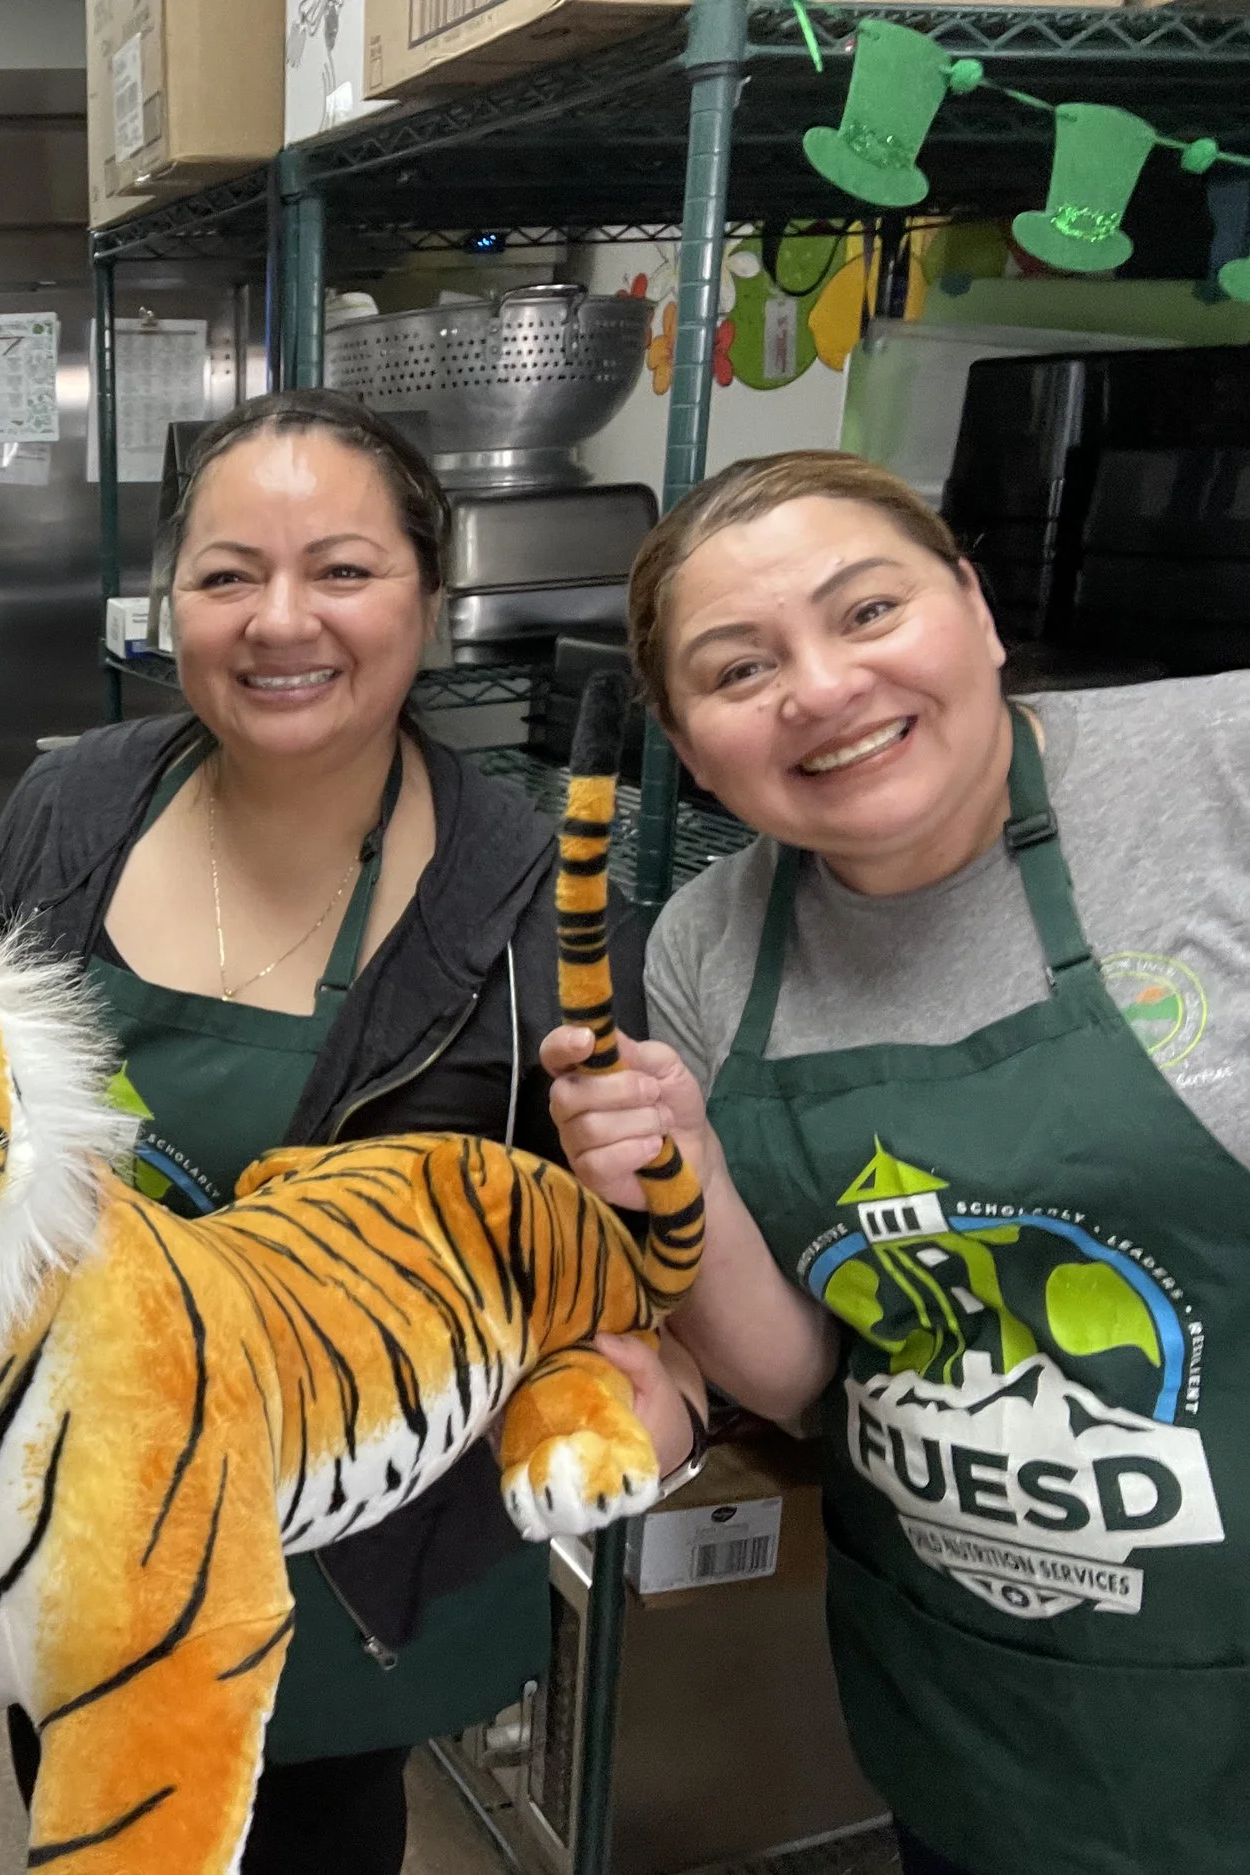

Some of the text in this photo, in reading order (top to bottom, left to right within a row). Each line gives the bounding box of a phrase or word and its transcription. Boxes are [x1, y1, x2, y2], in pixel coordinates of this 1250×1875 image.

[147, 1133, 221, 1198] SCHOLARLY
[1107, 1234, 1185, 1300] LEADERS
[858, 1403, 1183, 1532] FUESD
[1039, 1559, 1130, 1596] SERVICES
